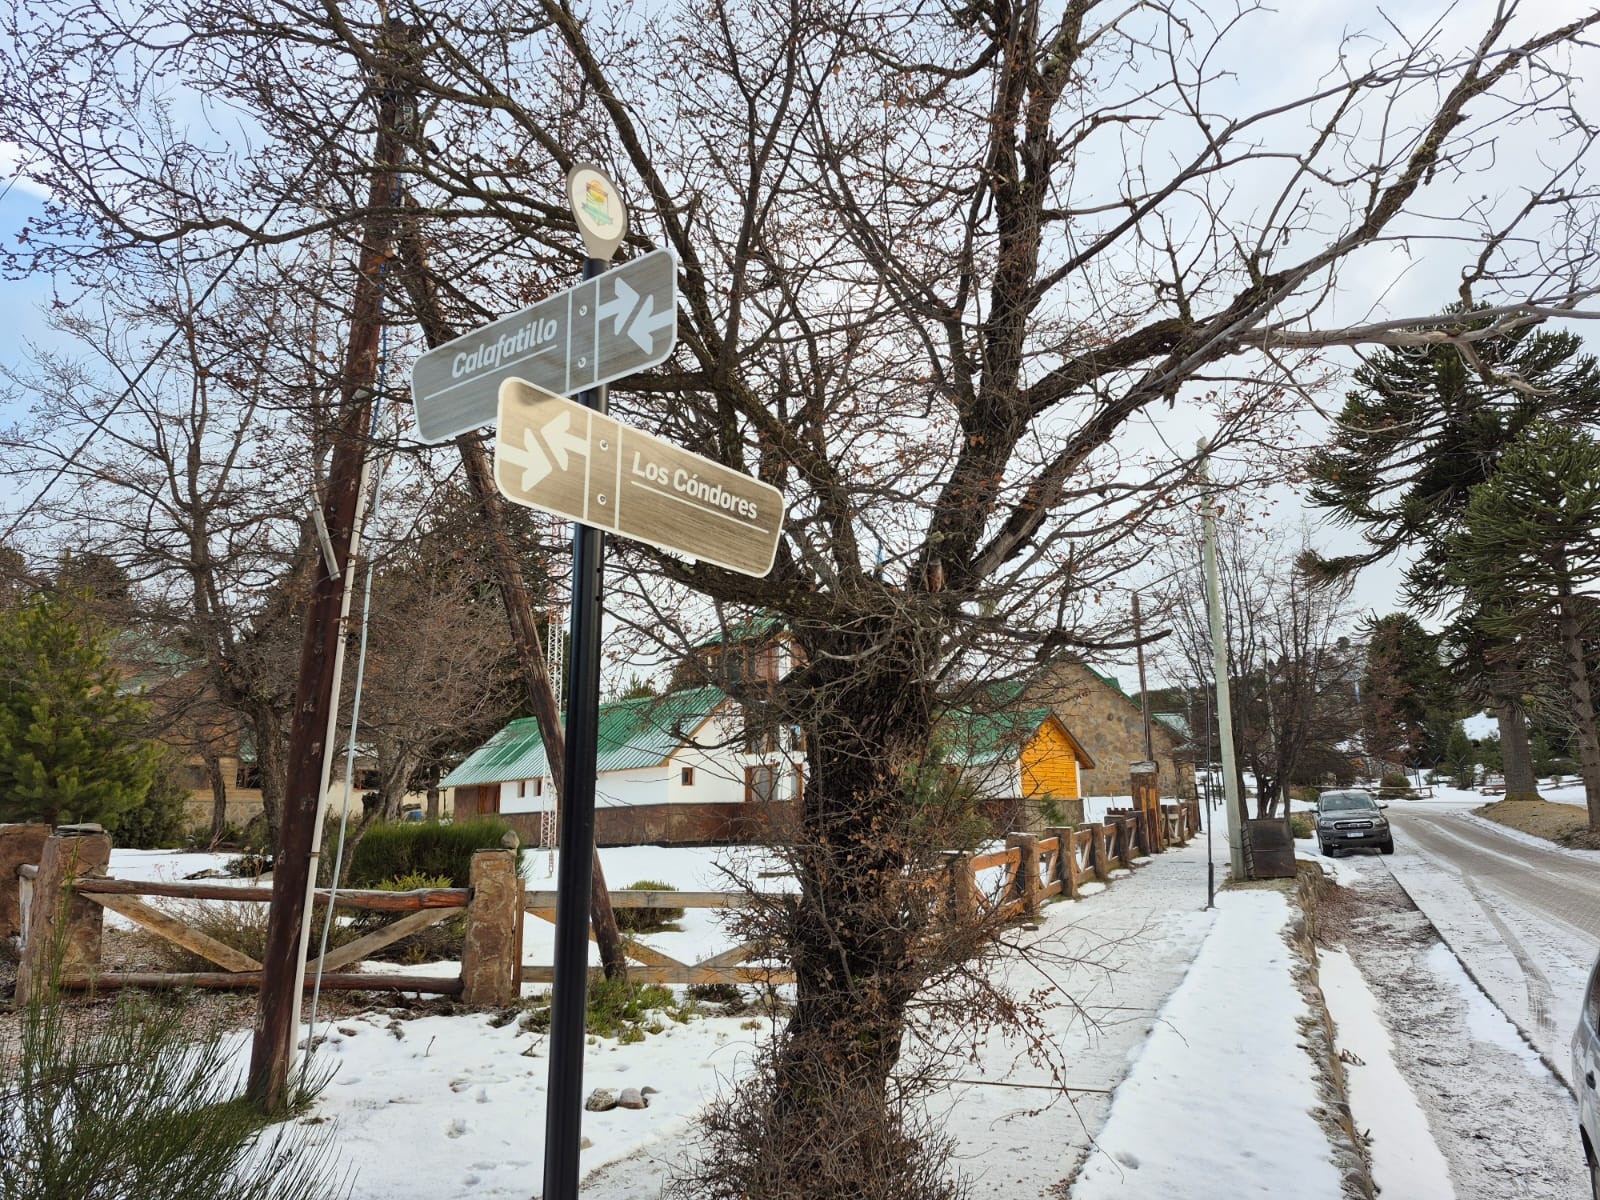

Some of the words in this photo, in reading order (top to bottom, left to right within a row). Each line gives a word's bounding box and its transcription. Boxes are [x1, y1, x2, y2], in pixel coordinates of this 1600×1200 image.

[451, 317, 558, 380] Calafatillo
[631, 451, 669, 485] Los
[673, 471, 758, 520] Cóndores
